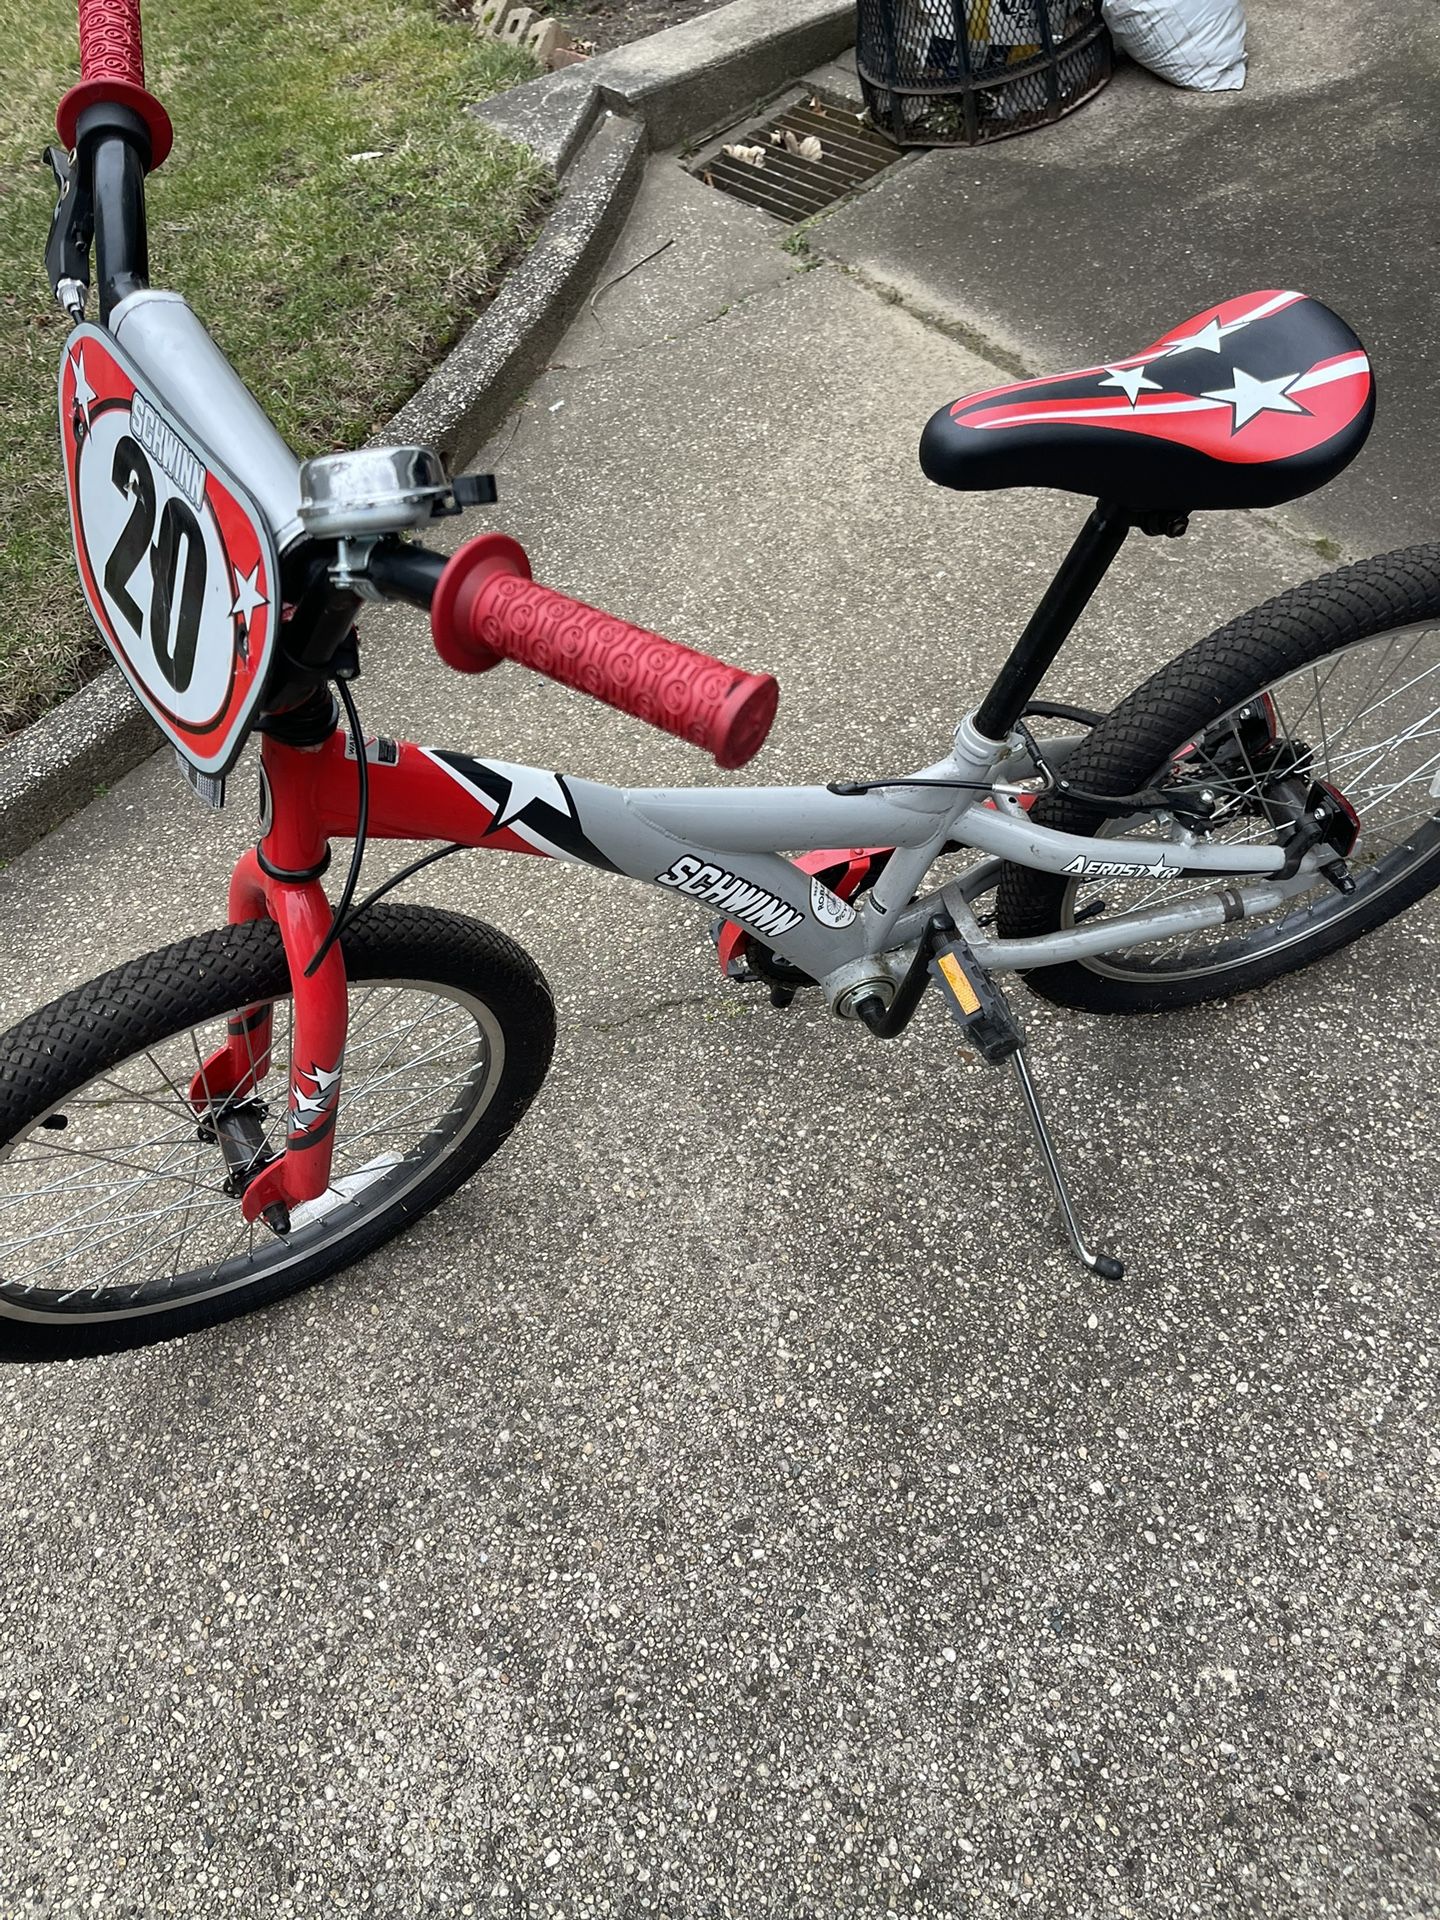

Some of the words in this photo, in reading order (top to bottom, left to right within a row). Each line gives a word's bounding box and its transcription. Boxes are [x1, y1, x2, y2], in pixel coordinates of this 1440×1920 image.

[131, 391, 207, 513] SCHWINN
[104, 435, 207, 693] 20
[654, 854, 805, 937] SCHWINN
